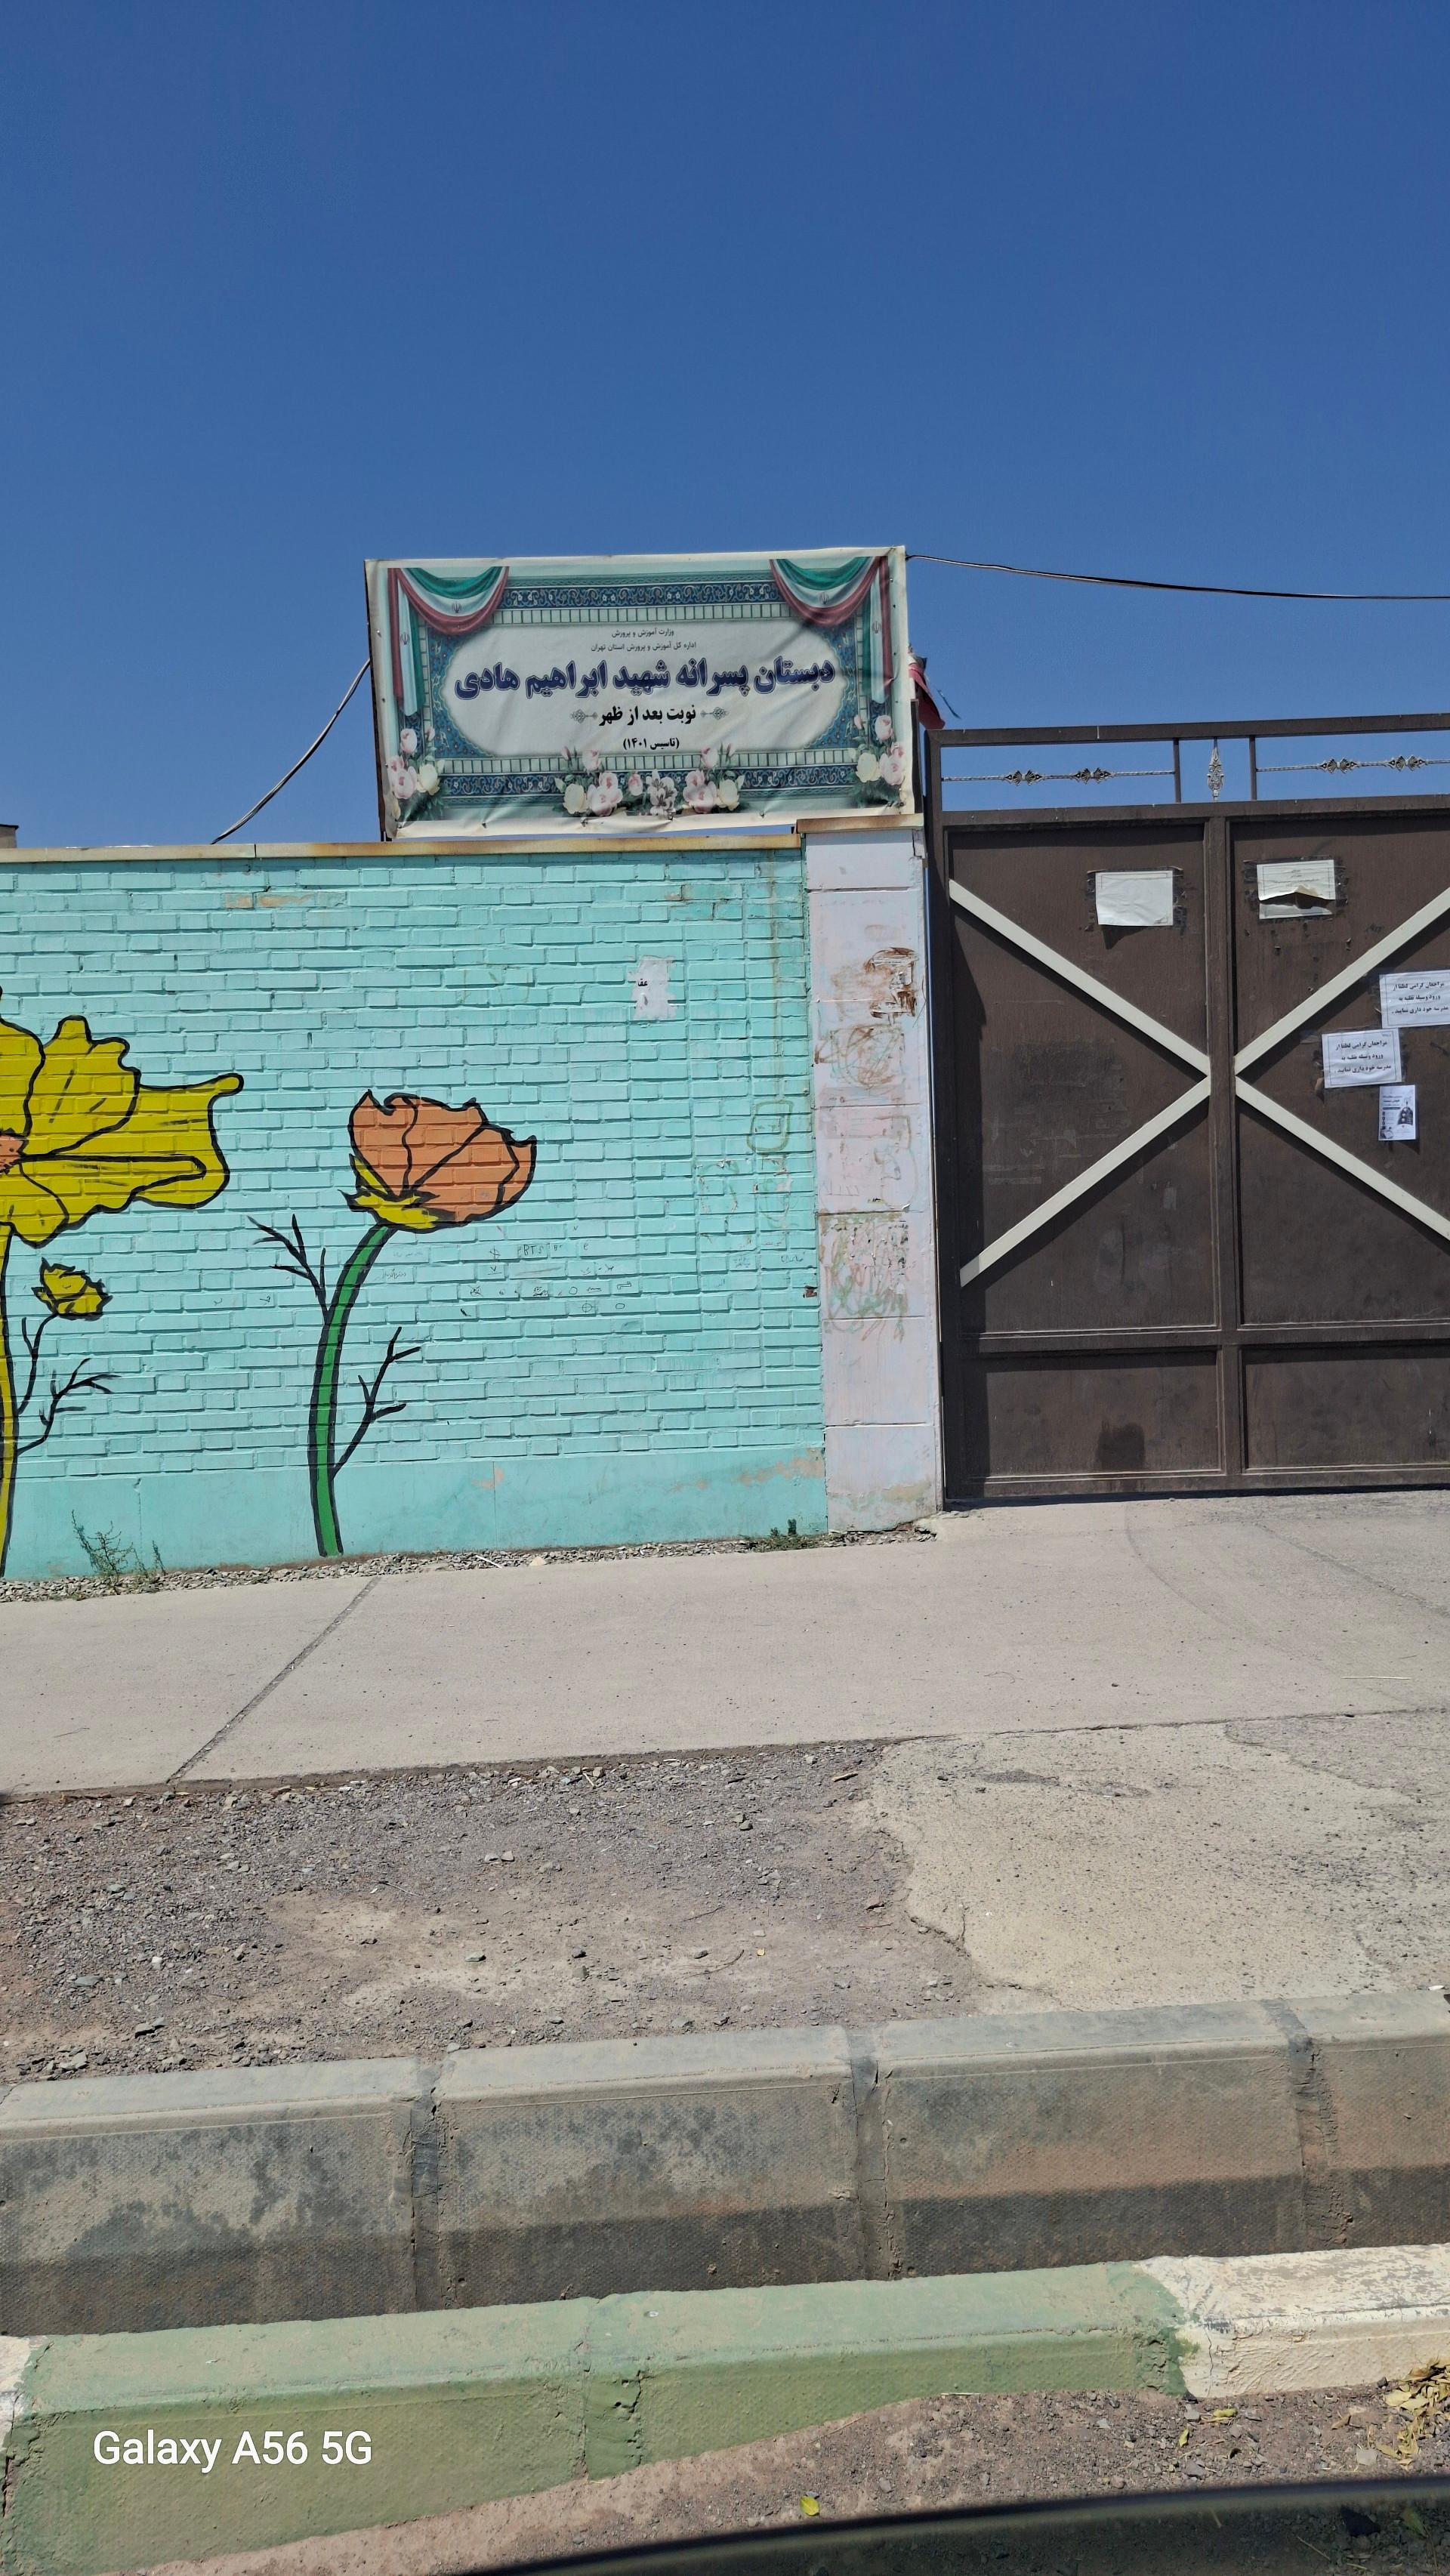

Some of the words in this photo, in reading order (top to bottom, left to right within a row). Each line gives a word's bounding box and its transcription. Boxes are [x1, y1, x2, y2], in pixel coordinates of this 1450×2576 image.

[611, 630, 631, 638] پرورش
[637, 628, 657, 638] آموزش
[658, 628, 674, 637] وزارت
[591, 643, 606, 652] تهران
[627, 643, 646, 652] پرورش
[652, 641, 671, 651] آموزش
[673, 642, 681, 650] کل
[683, 641, 696, 650] اداره
[454, 662, 521, 701] هادی
[525, 659, 609, 699] ابراهیم
[612, 659, 671, 696] شهید
[675, 658, 751, 697] پسرانه
[753, 656, 835, 695] دبستان
[598, 705, 624, 727] ظهر
[627, 705, 639, 726] از
[642, 708, 663, 724] بعد
[666, 705, 696, 724] نوبت
